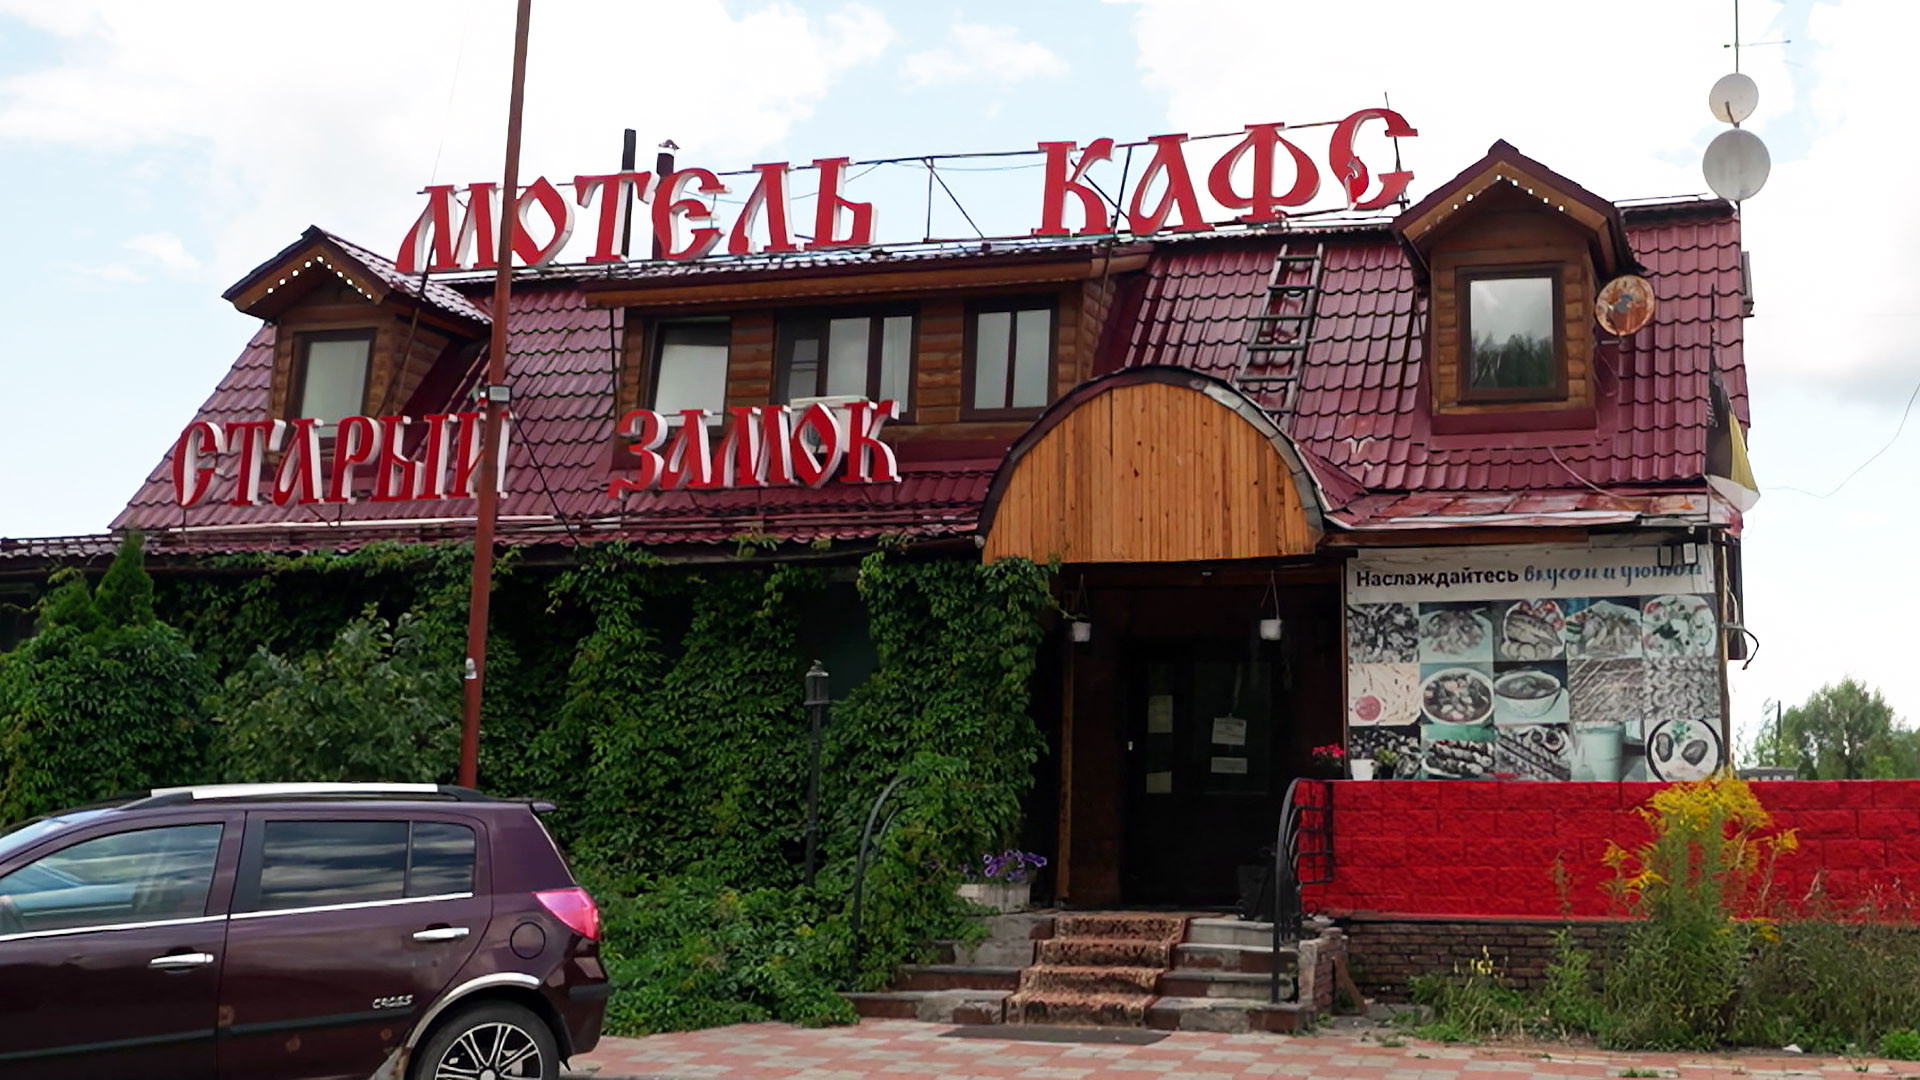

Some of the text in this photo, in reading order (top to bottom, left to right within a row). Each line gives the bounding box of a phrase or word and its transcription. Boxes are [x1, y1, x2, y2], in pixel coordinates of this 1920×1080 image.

[395, 156, 878, 272] МОТЕЛЬ
[607, 399, 902, 499] ЗАМОК
[1356, 566, 1519, 588] Наслаждайтесь
[1602, 566, 1616, 581] и
